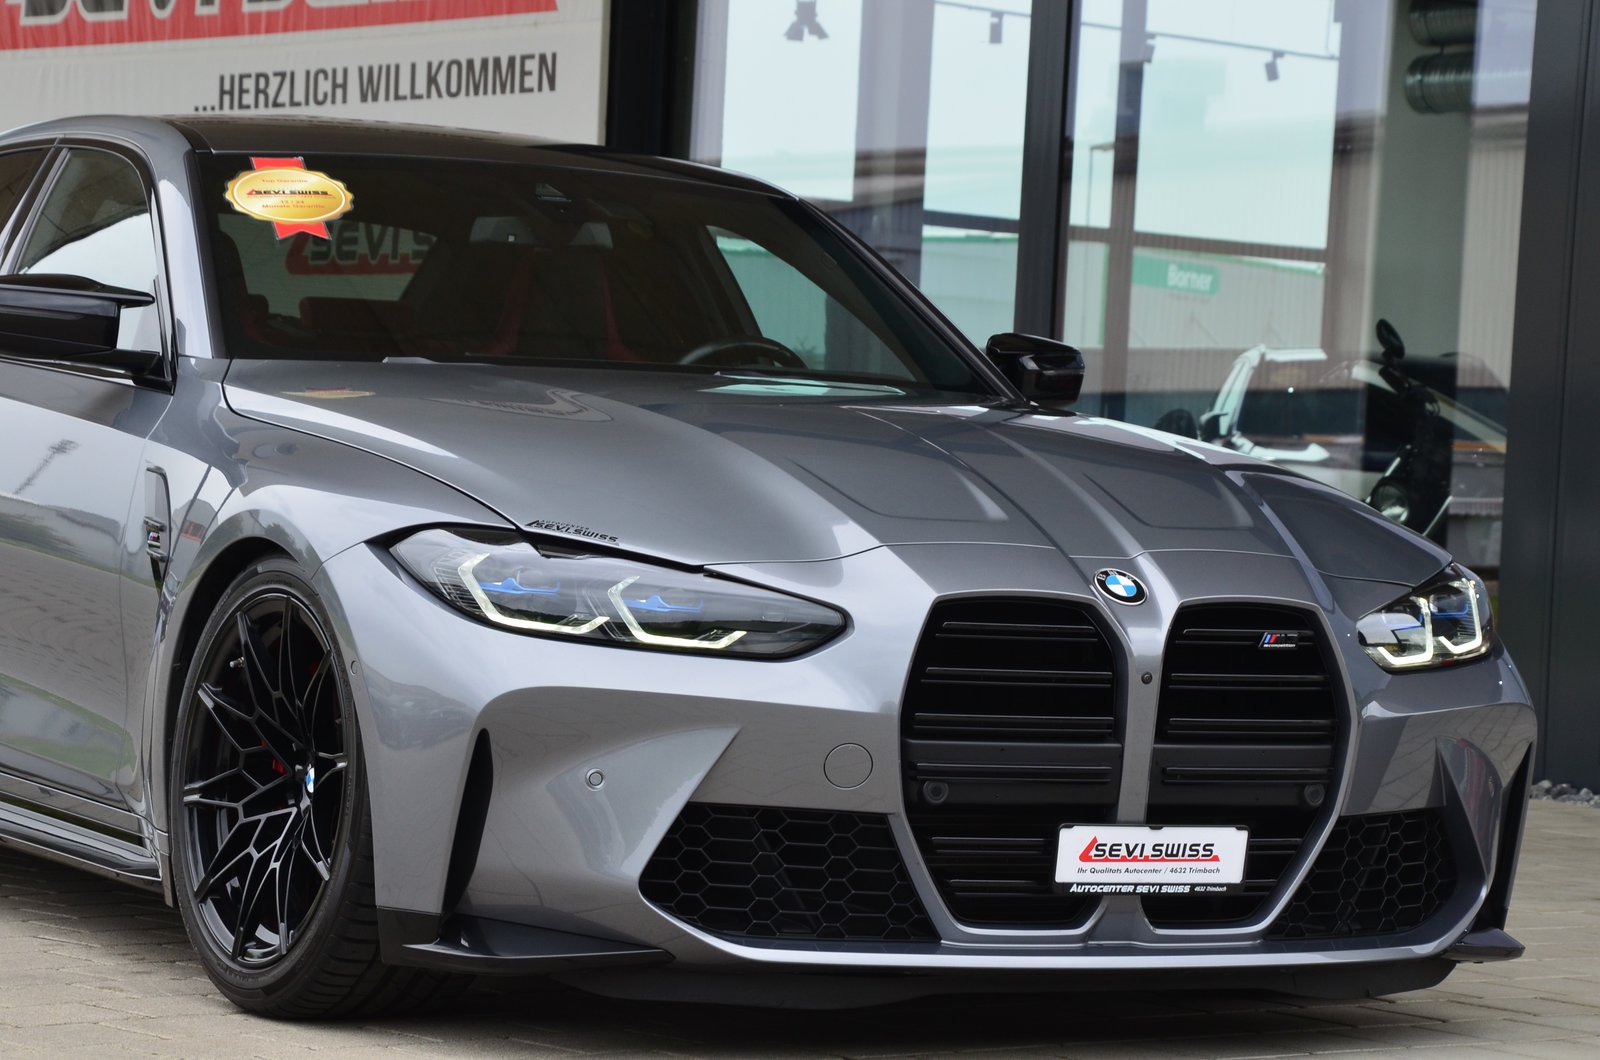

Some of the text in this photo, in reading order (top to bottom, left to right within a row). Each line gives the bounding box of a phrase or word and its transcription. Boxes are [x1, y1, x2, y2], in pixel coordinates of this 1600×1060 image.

[194, 52, 557, 112] ...HERZLICH WILLKOMMEN
[534, 522, 619, 543] SEVI SWISS
[1093, 843, 1215, 858] SEVI SWISS
[1069, 883, 1135, 893] AUTOCENTER
[1135, 884, 1160, 893] SEVI
[1160, 884, 1191, 893] SWISS
